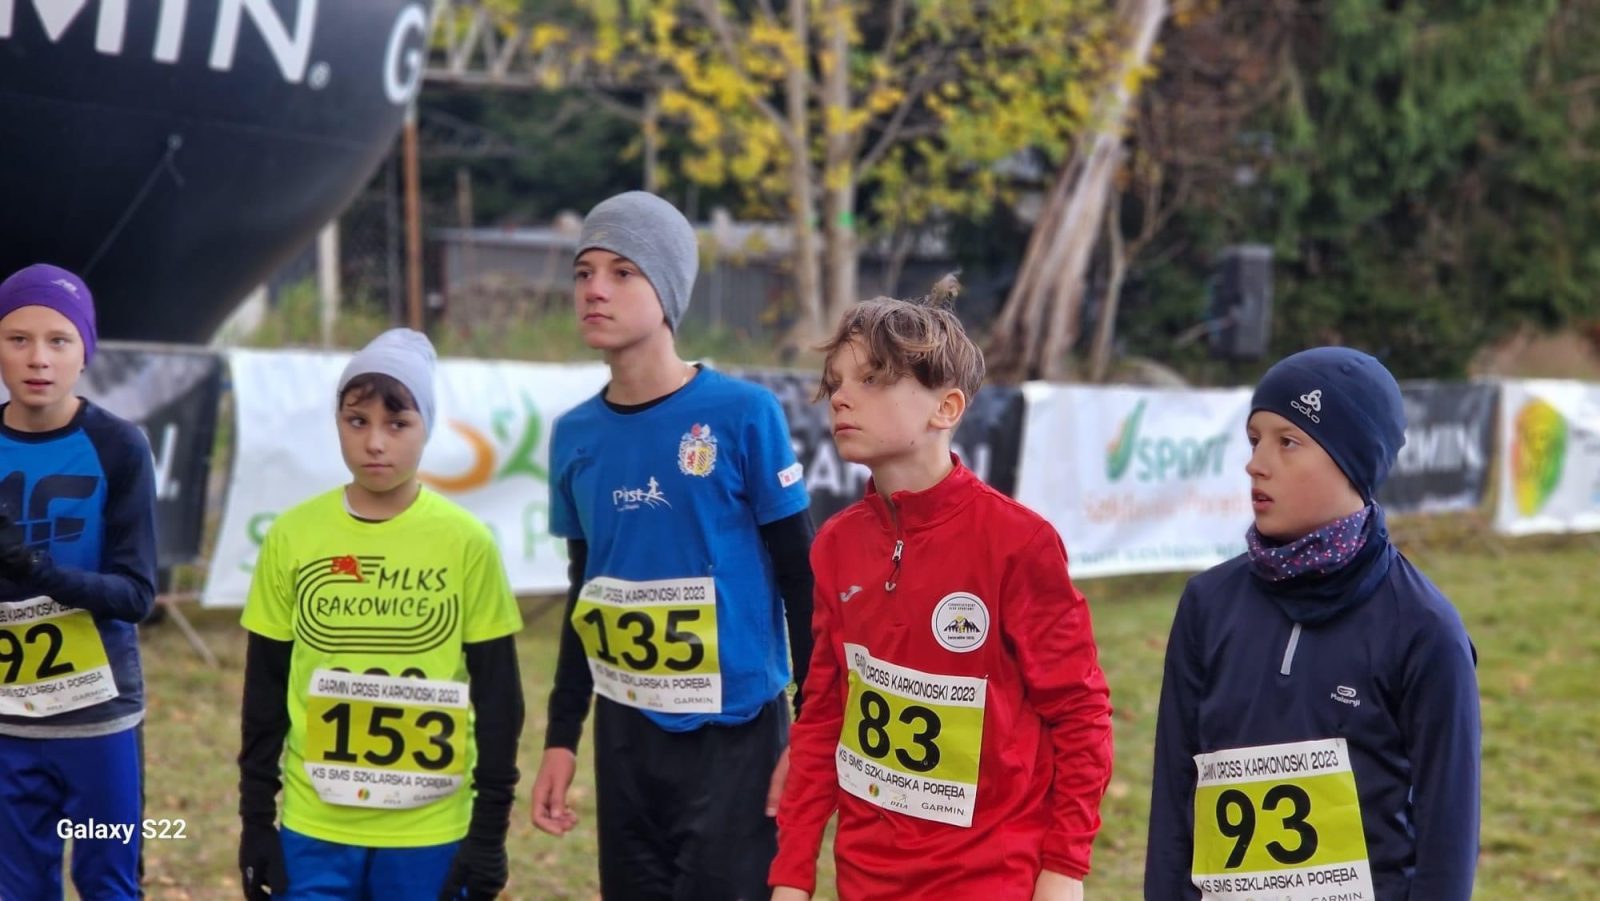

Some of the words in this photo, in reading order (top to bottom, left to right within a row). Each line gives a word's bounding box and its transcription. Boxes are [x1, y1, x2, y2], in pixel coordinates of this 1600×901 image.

[1290, 400, 1320, 424] odlo
[377, 567, 447, 592] MLKS
[683, 586, 705, 601] 2023
[316, 596, 429, 617] RAKOWICE
[583, 608, 705, 671] 135
[350, 682, 380, 698] CROSS
[672, 677, 712, 691] PORĘBA
[866, 664, 890, 687] CROSS
[891, 674, 948, 700] KARKONOSKI
[950, 686, 976, 701] 2023
[321, 702, 455, 770] 153
[858, 690, 942, 772] 83
[839, 747, 848, 762] KS
[848, 755, 863, 772] SMS
[864, 763, 920, 791] SZKLARSKA
[922, 782, 966, 800] PORĘBA
[1217, 760, 1243, 779] CROSS
[1244, 753, 1308, 776] KARKONOSKI
[1310, 750, 1339, 769] 2023
[312, 768, 326, 779] KS
[328, 770, 350, 782] SMS
[353, 771, 411, 787] SZKLARSKA
[921, 802, 965, 816] GARMIN
[1216, 784, 1318, 868] 93
[1199, 880, 1212, 893] KS
[1213, 879, 1232, 893] SMS
[1234, 873, 1305, 892] SZKLARSKA
[1307, 867, 1358, 886] PORĘBA
